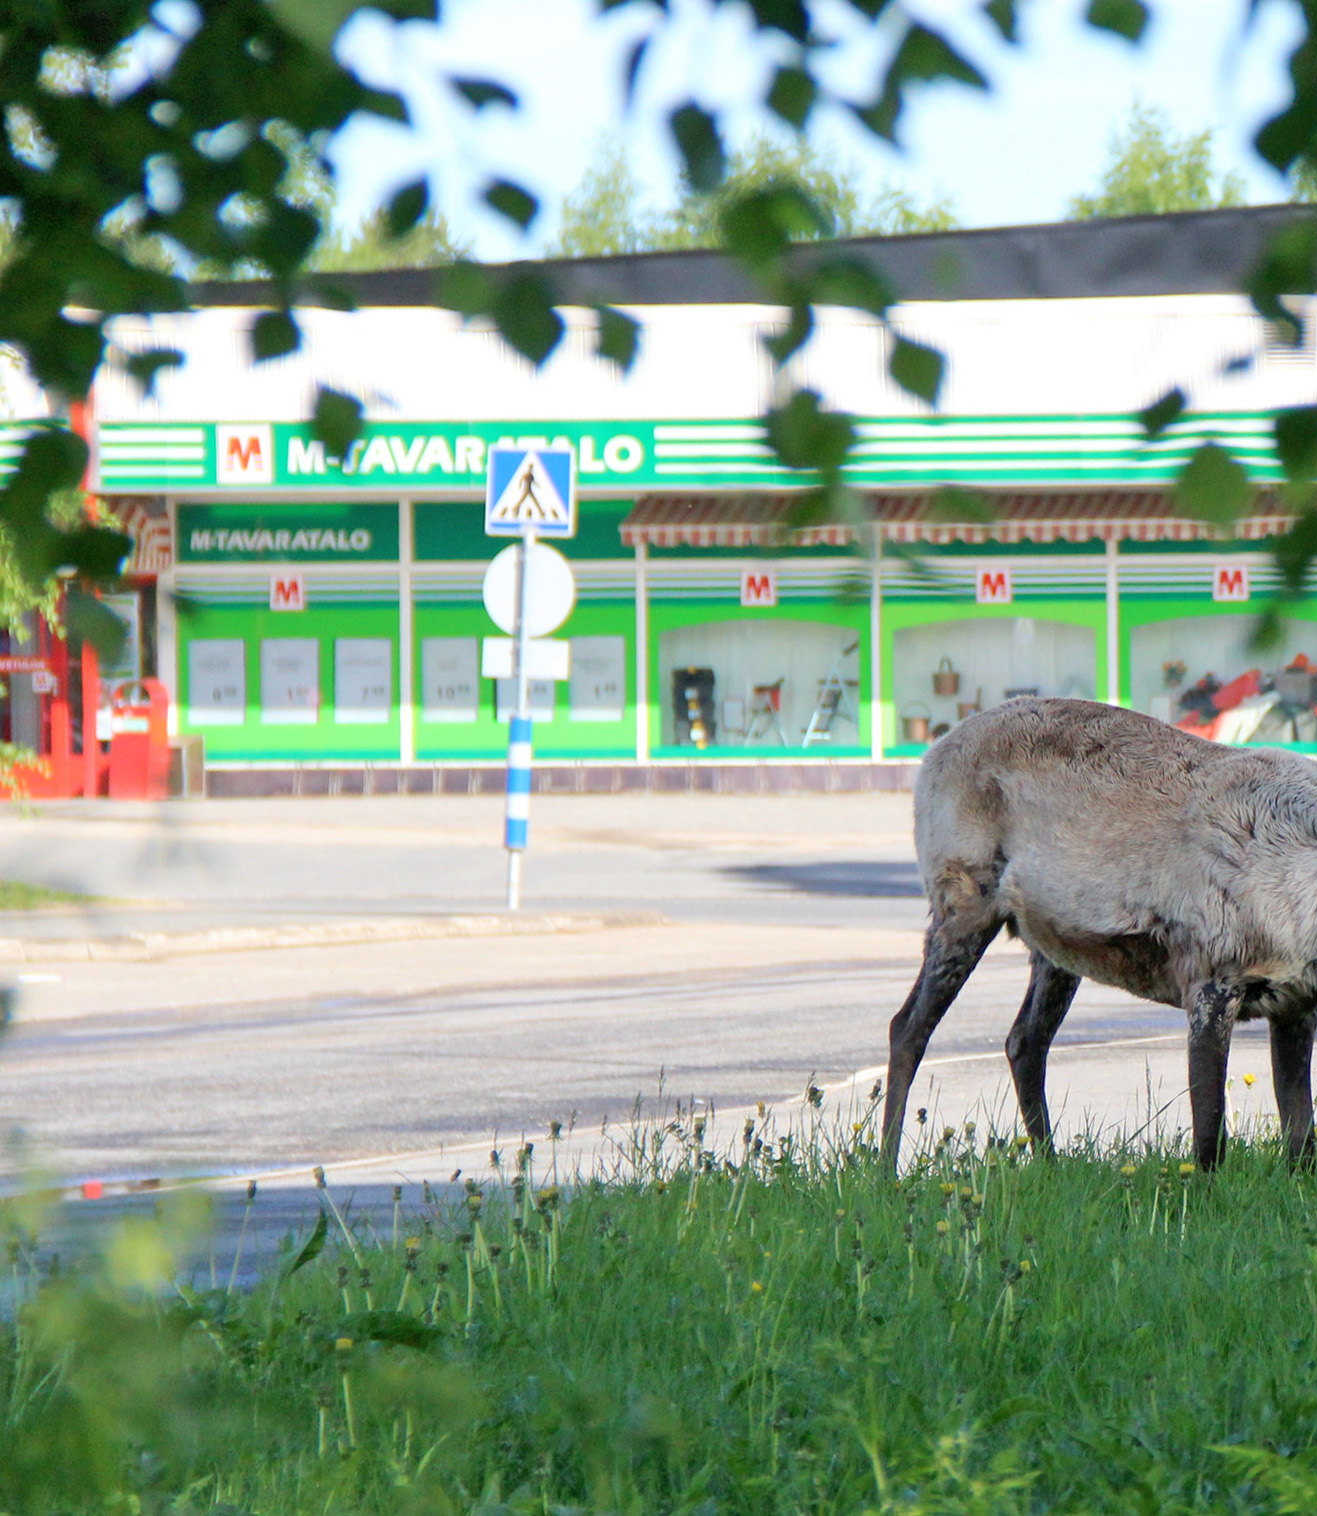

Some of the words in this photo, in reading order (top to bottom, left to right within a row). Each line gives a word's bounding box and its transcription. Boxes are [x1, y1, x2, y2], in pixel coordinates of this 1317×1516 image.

[225, 435, 264, 472] M
[190, 528, 372, 552] M-TAVARATALO
[274, 580, 300, 603] M
[745, 575, 771, 600] M
[981, 572, 1006, 598] M
[1218, 570, 1244, 596] M
